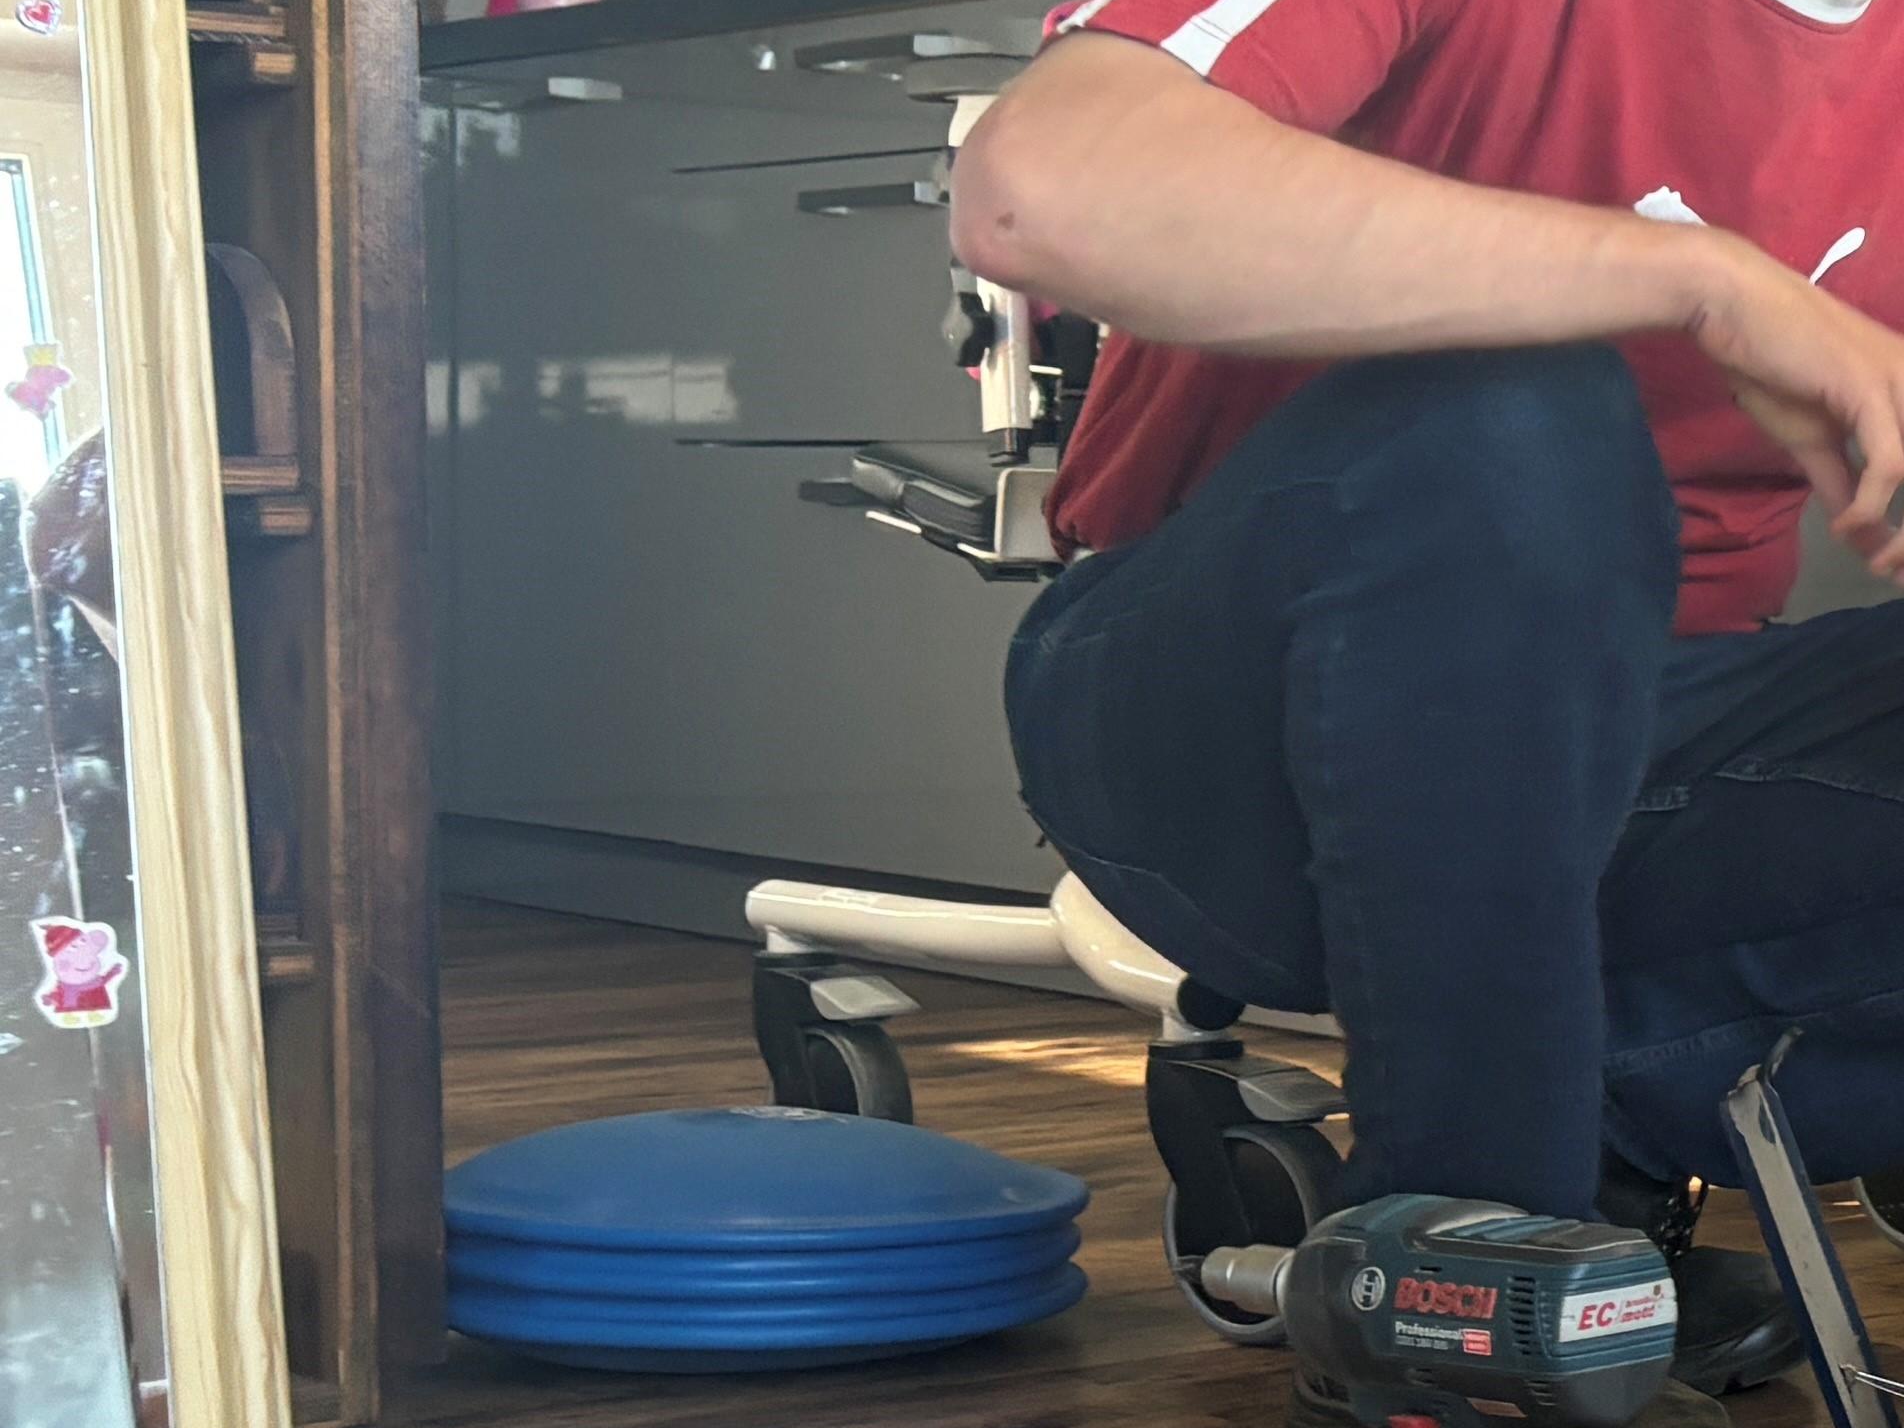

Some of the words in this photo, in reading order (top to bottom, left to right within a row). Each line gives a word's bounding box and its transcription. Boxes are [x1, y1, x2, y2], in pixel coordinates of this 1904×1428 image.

[1394, 1278, 1498, 1320] BOSCH
[1578, 1302, 1616, 1330] EC
[1395, 1321, 1464, 1341] Professional
